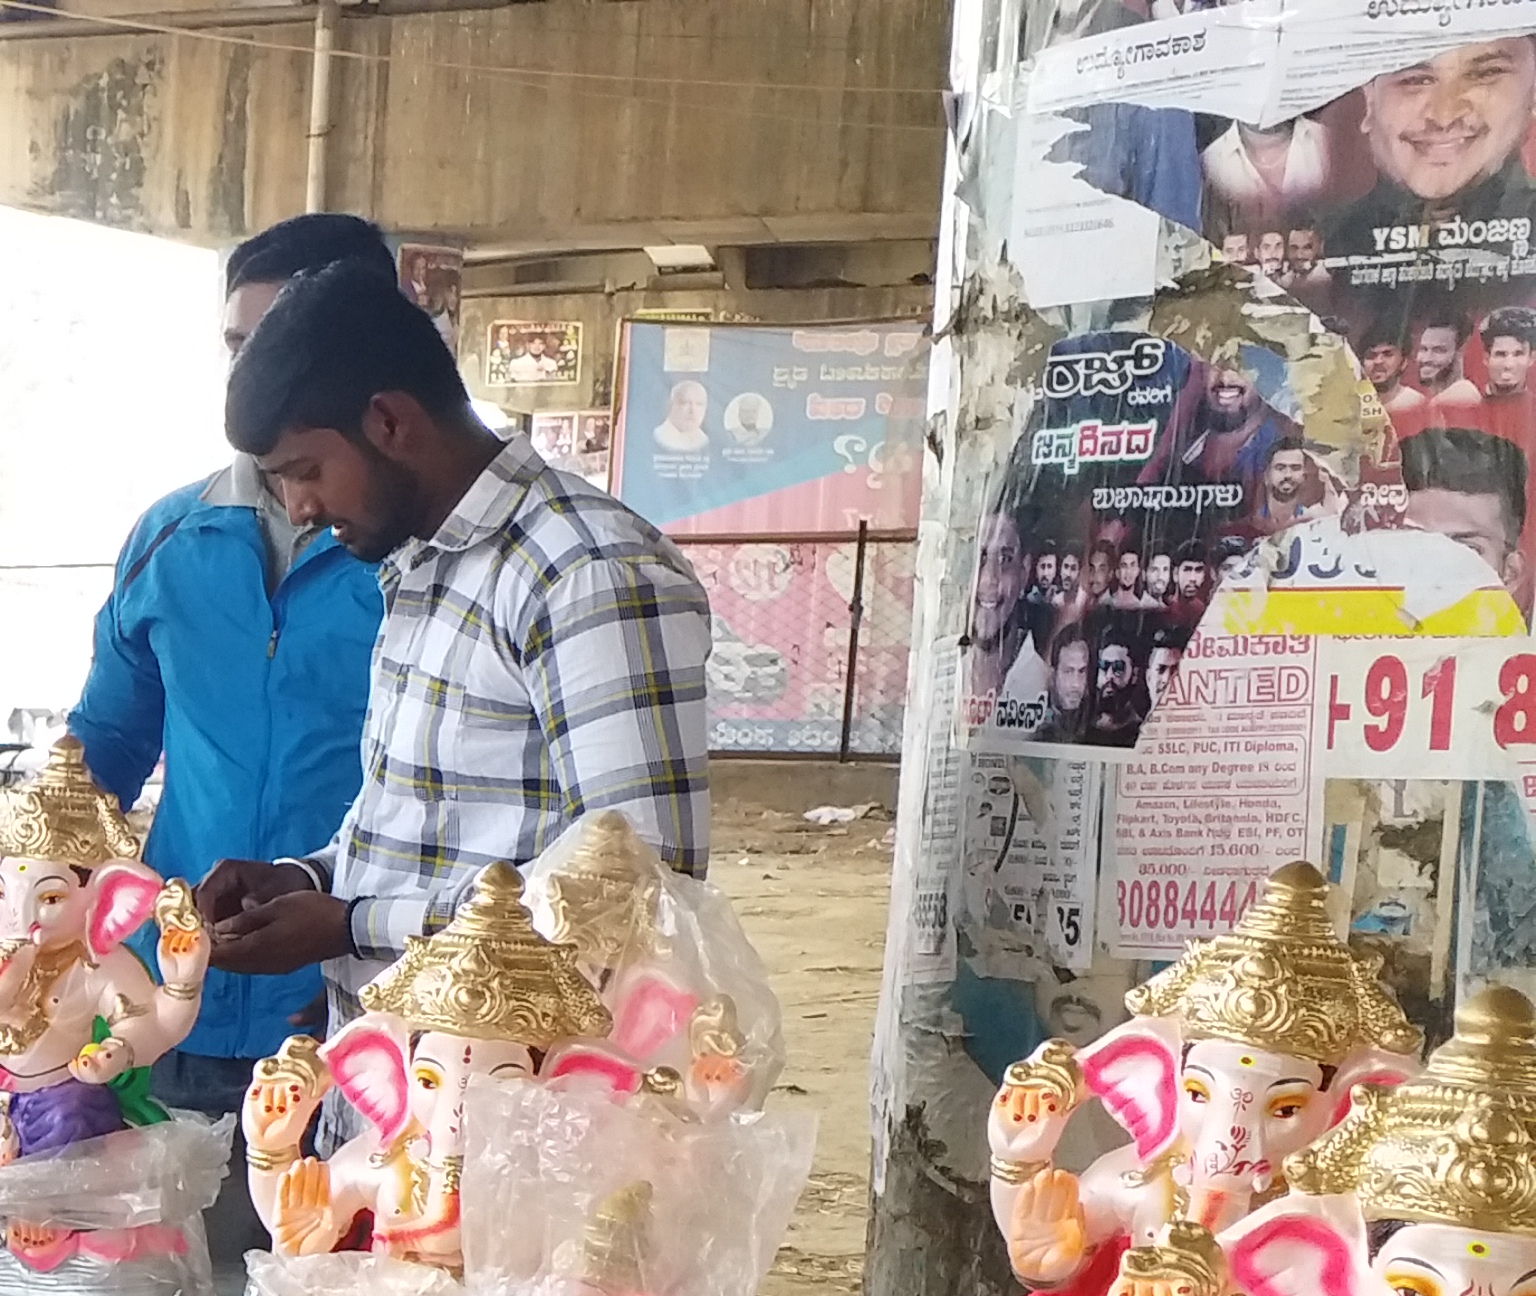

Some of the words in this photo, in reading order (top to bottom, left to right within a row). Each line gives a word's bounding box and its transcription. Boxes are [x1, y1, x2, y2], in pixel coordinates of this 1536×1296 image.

[1373, 225, 1429, 251] YSM
[1032, 419, 1158, 475] ಜನ್ಮದಿನದ
[1092, 483, 1244, 515] ಶುಭಾಷಯಗಳು
[1157, 665, 1310, 706] ANTED
[1158, 742, 1189, 756] SSLC,
[1193, 742, 1221, 756] PUC,
[1224, 741, 1240, 753] ITI
[1244, 740, 1298, 756] Diploma,
[1150, 763, 1185, 775] B.Com
[1188, 764, 1208, 776] any
[1212, 761, 1254, 776] Degree
[1149, 828, 1172, 838] Axis
[1175, 827, 1203, 837] Bank
